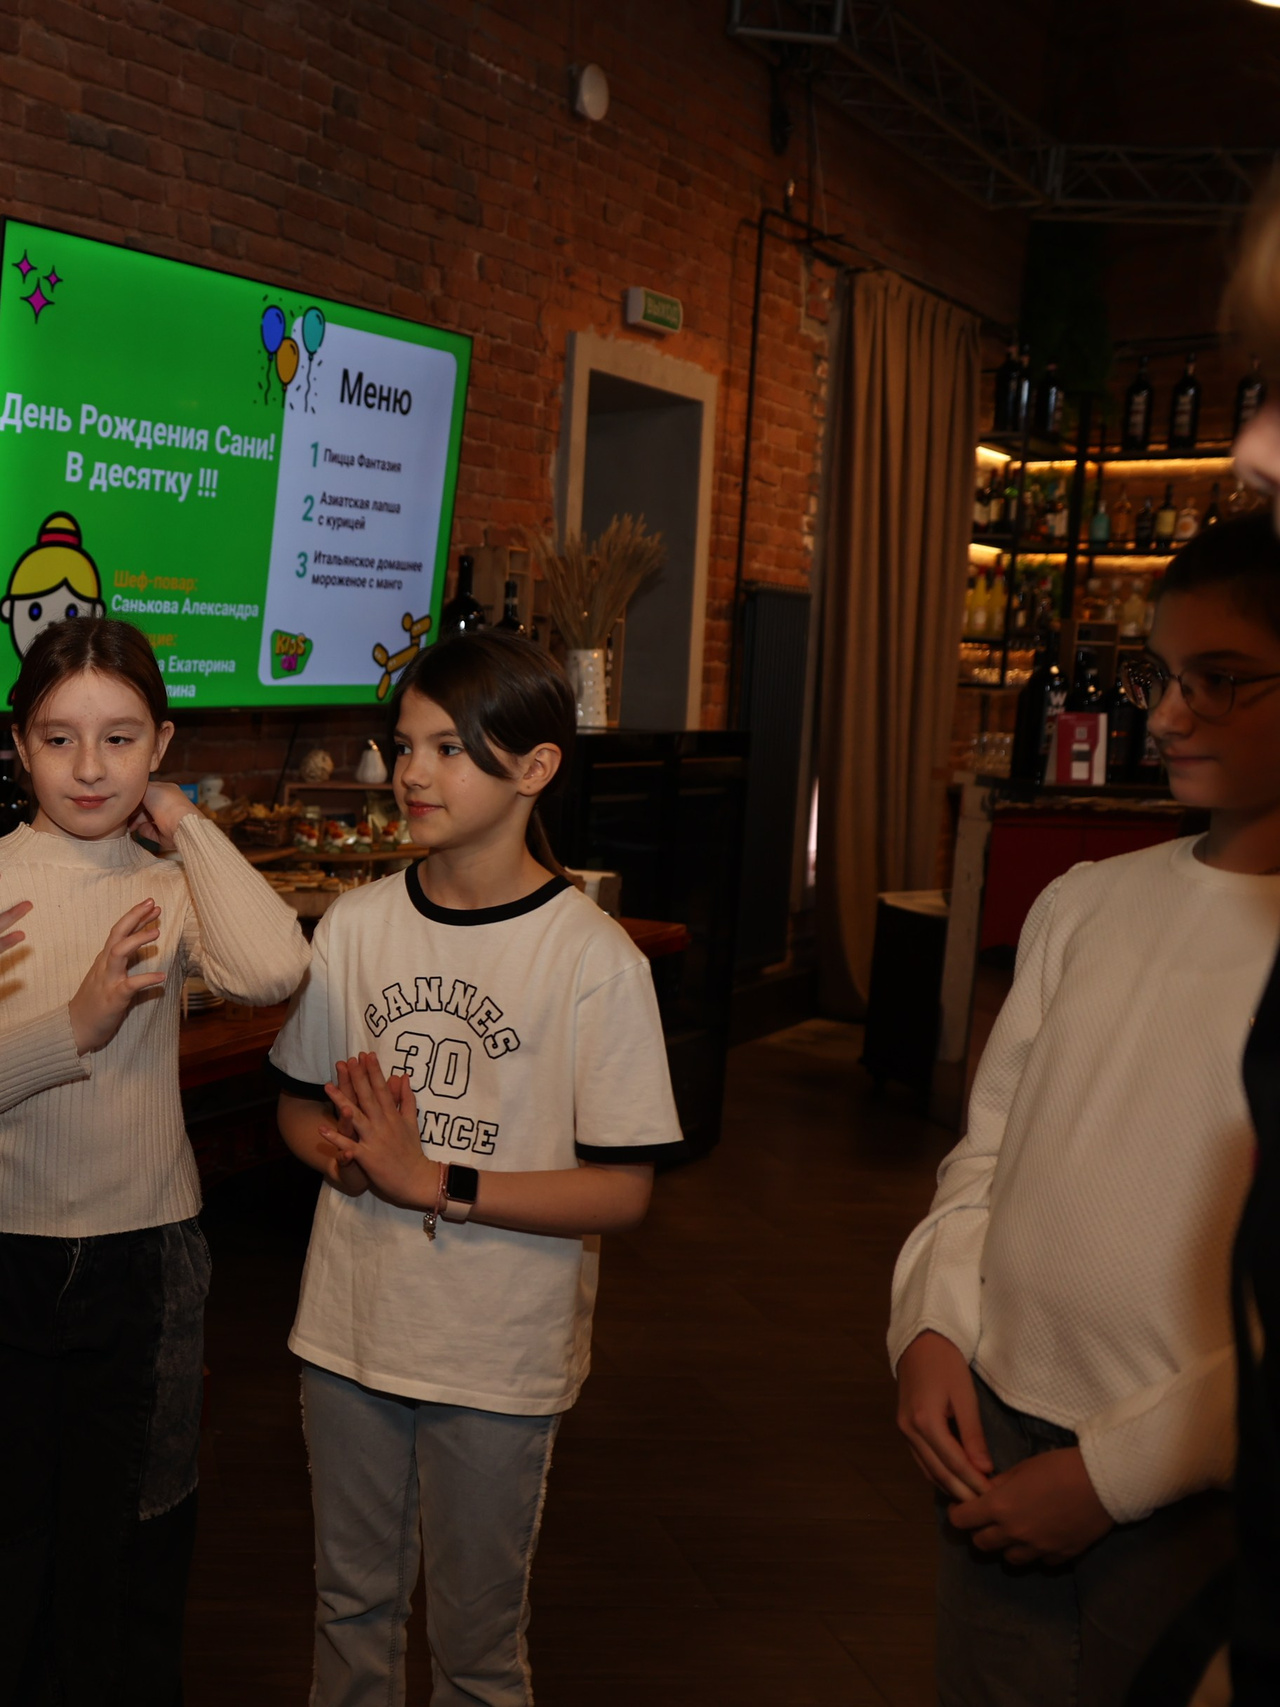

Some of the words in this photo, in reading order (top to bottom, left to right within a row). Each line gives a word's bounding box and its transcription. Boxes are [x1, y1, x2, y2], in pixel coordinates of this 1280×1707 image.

[340, 368, 412, 415] Меню
[79, 403, 210, 452] Рождения
[215, 425, 276, 461] Сани!
[310, 442, 319, 468] 1
[324, 448, 355, 468] Пицца
[357, 457, 402, 473] Фантазия
[65, 451, 84, 483] В
[88, 461, 193, 503] десятку
[302, 495, 314, 521] 2
[320, 492, 370, 510] Азиатская
[371, 501, 401, 514] лапша
[318, 514, 324, 526] с
[326, 515, 366, 531] курицей
[295, 552, 308, 578] 3
[313, 550, 375, 569] Итальянское
[376, 560, 423, 573] домашнее
[114, 569, 199, 595] Шеф-повар:
[312, 574, 367, 590] мороженое
[369, 577, 375, 588] с
[376, 578, 403, 591] манго
[111, 594, 179, 614] Санькова
[181, 598, 260, 621] Александра
[168, 655, 236, 677] Екатерина
[364, 976, 520, 1059] CANNES
[391, 1030, 471, 1099] 30
[416, 1109, 499, 1155] NCE
